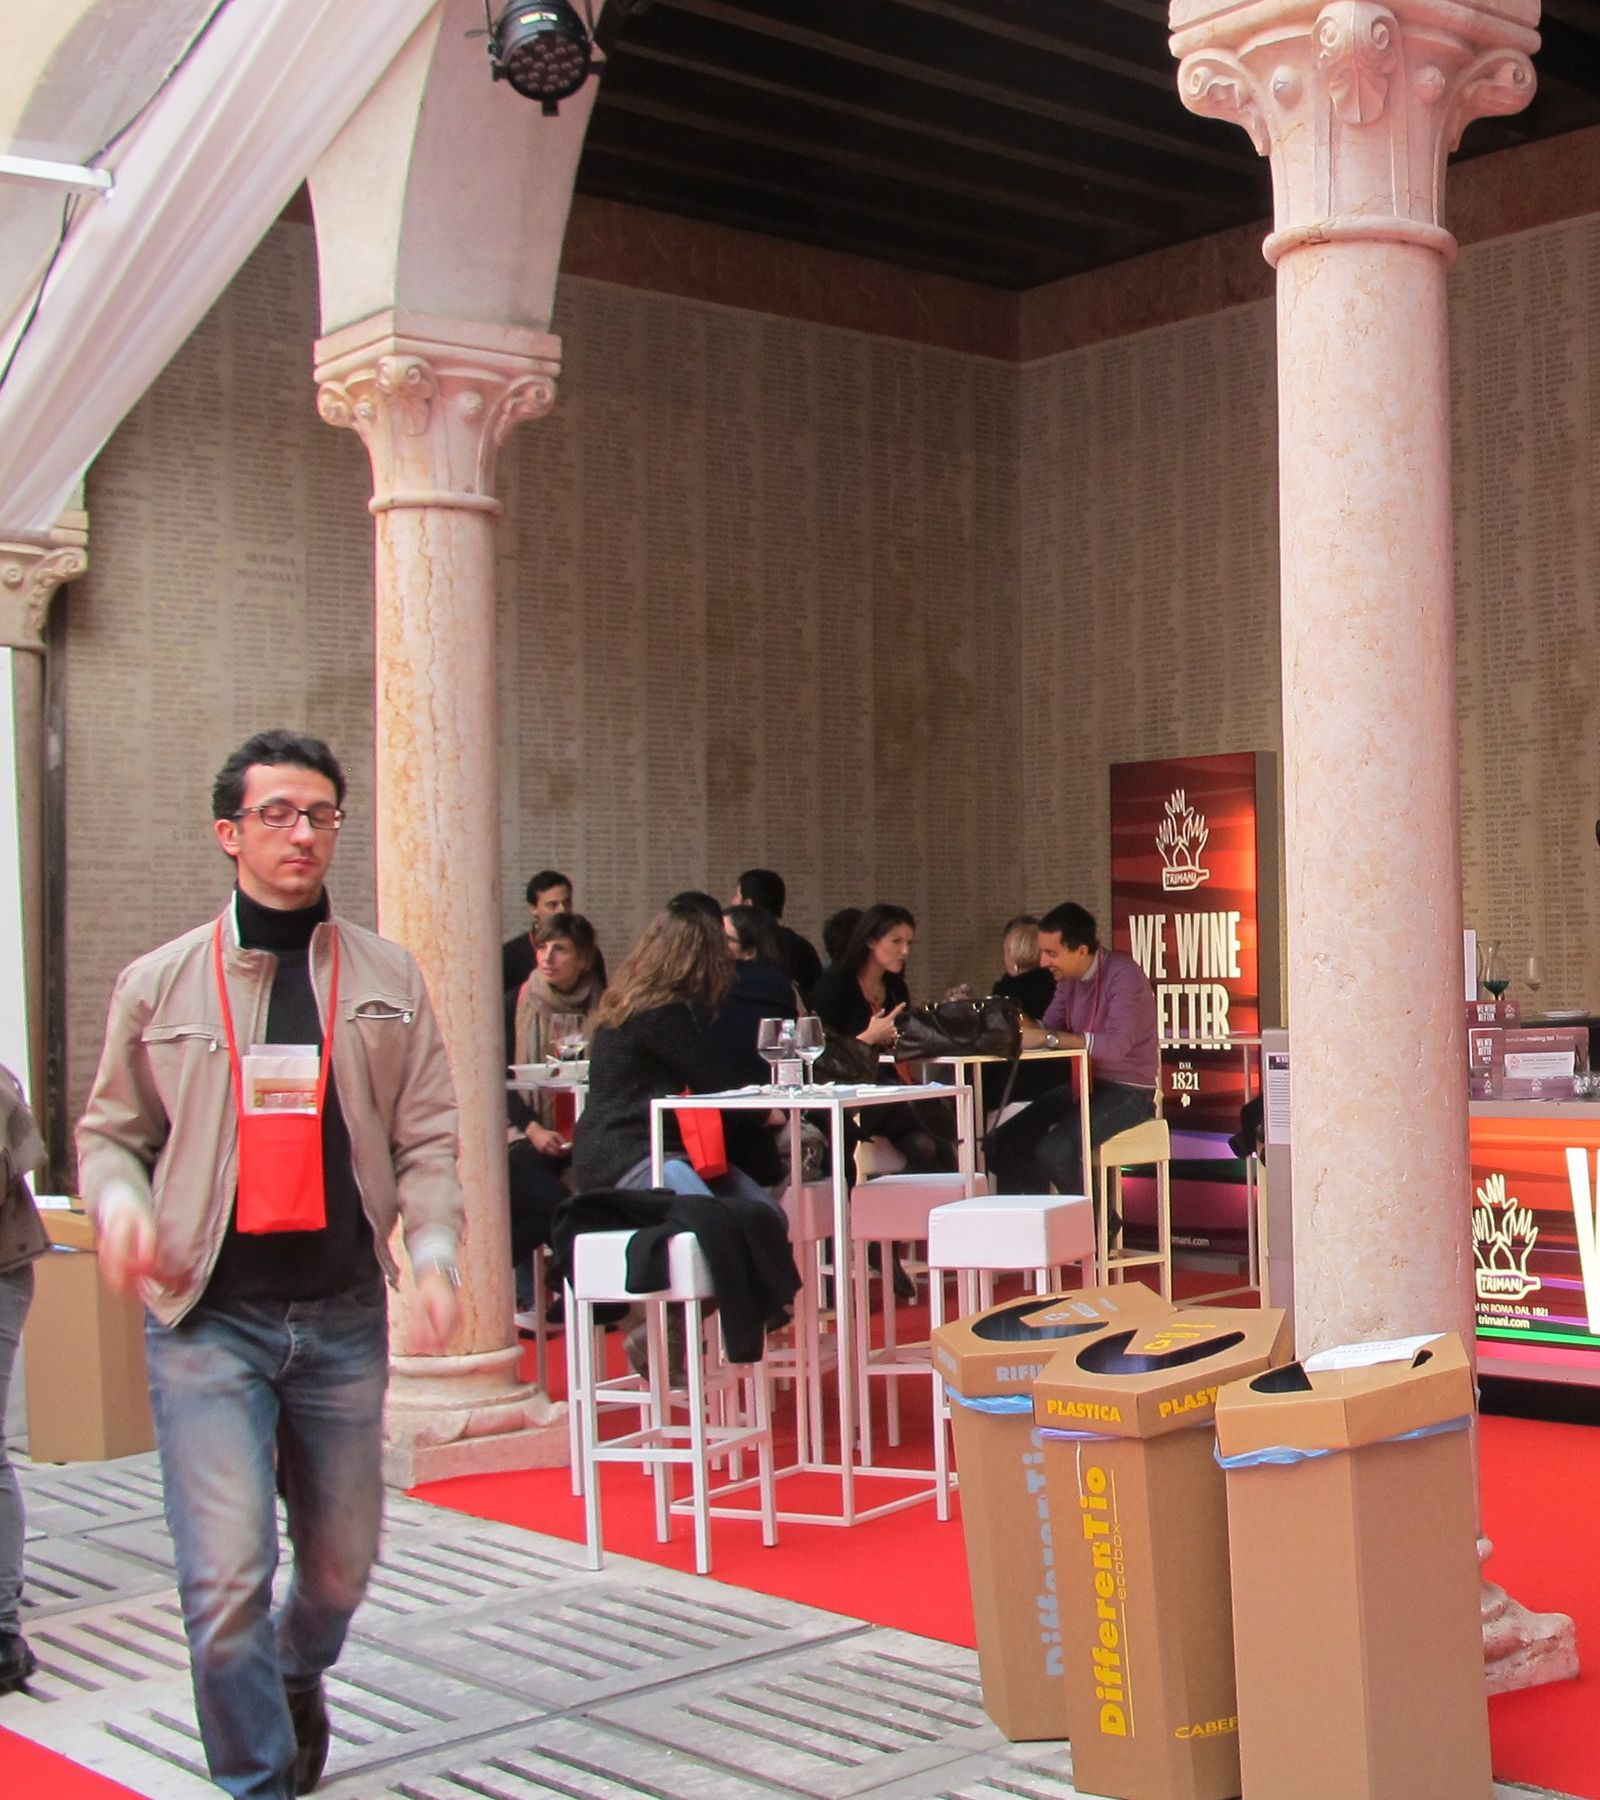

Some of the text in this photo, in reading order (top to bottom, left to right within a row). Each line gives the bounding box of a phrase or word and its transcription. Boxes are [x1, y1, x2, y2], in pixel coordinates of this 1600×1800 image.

[1166, 872, 1198, 885] TRIMANI
[1129, 911, 1242, 979] WE WINE
[1156, 983, 1232, 1051] ETTER
[1171, 1072, 1200, 1090] 1821
[1481, 1276, 1524, 1292] TRIMANI
[1480, 1303, 1490, 1312] IN
[1491, 1303, 1514, 1314] ROMA
[1515, 1305, 1530, 1315] DAL
[1532, 1307, 1549, 1317] 1821
[1478, 1315, 1530, 1329] trimani.com
[1047, 1399, 1121, 1423] PLASTICA
[1112, 1523, 1127, 1601] ecobox
[1081, 1466, 1127, 1737] DifferenTio
